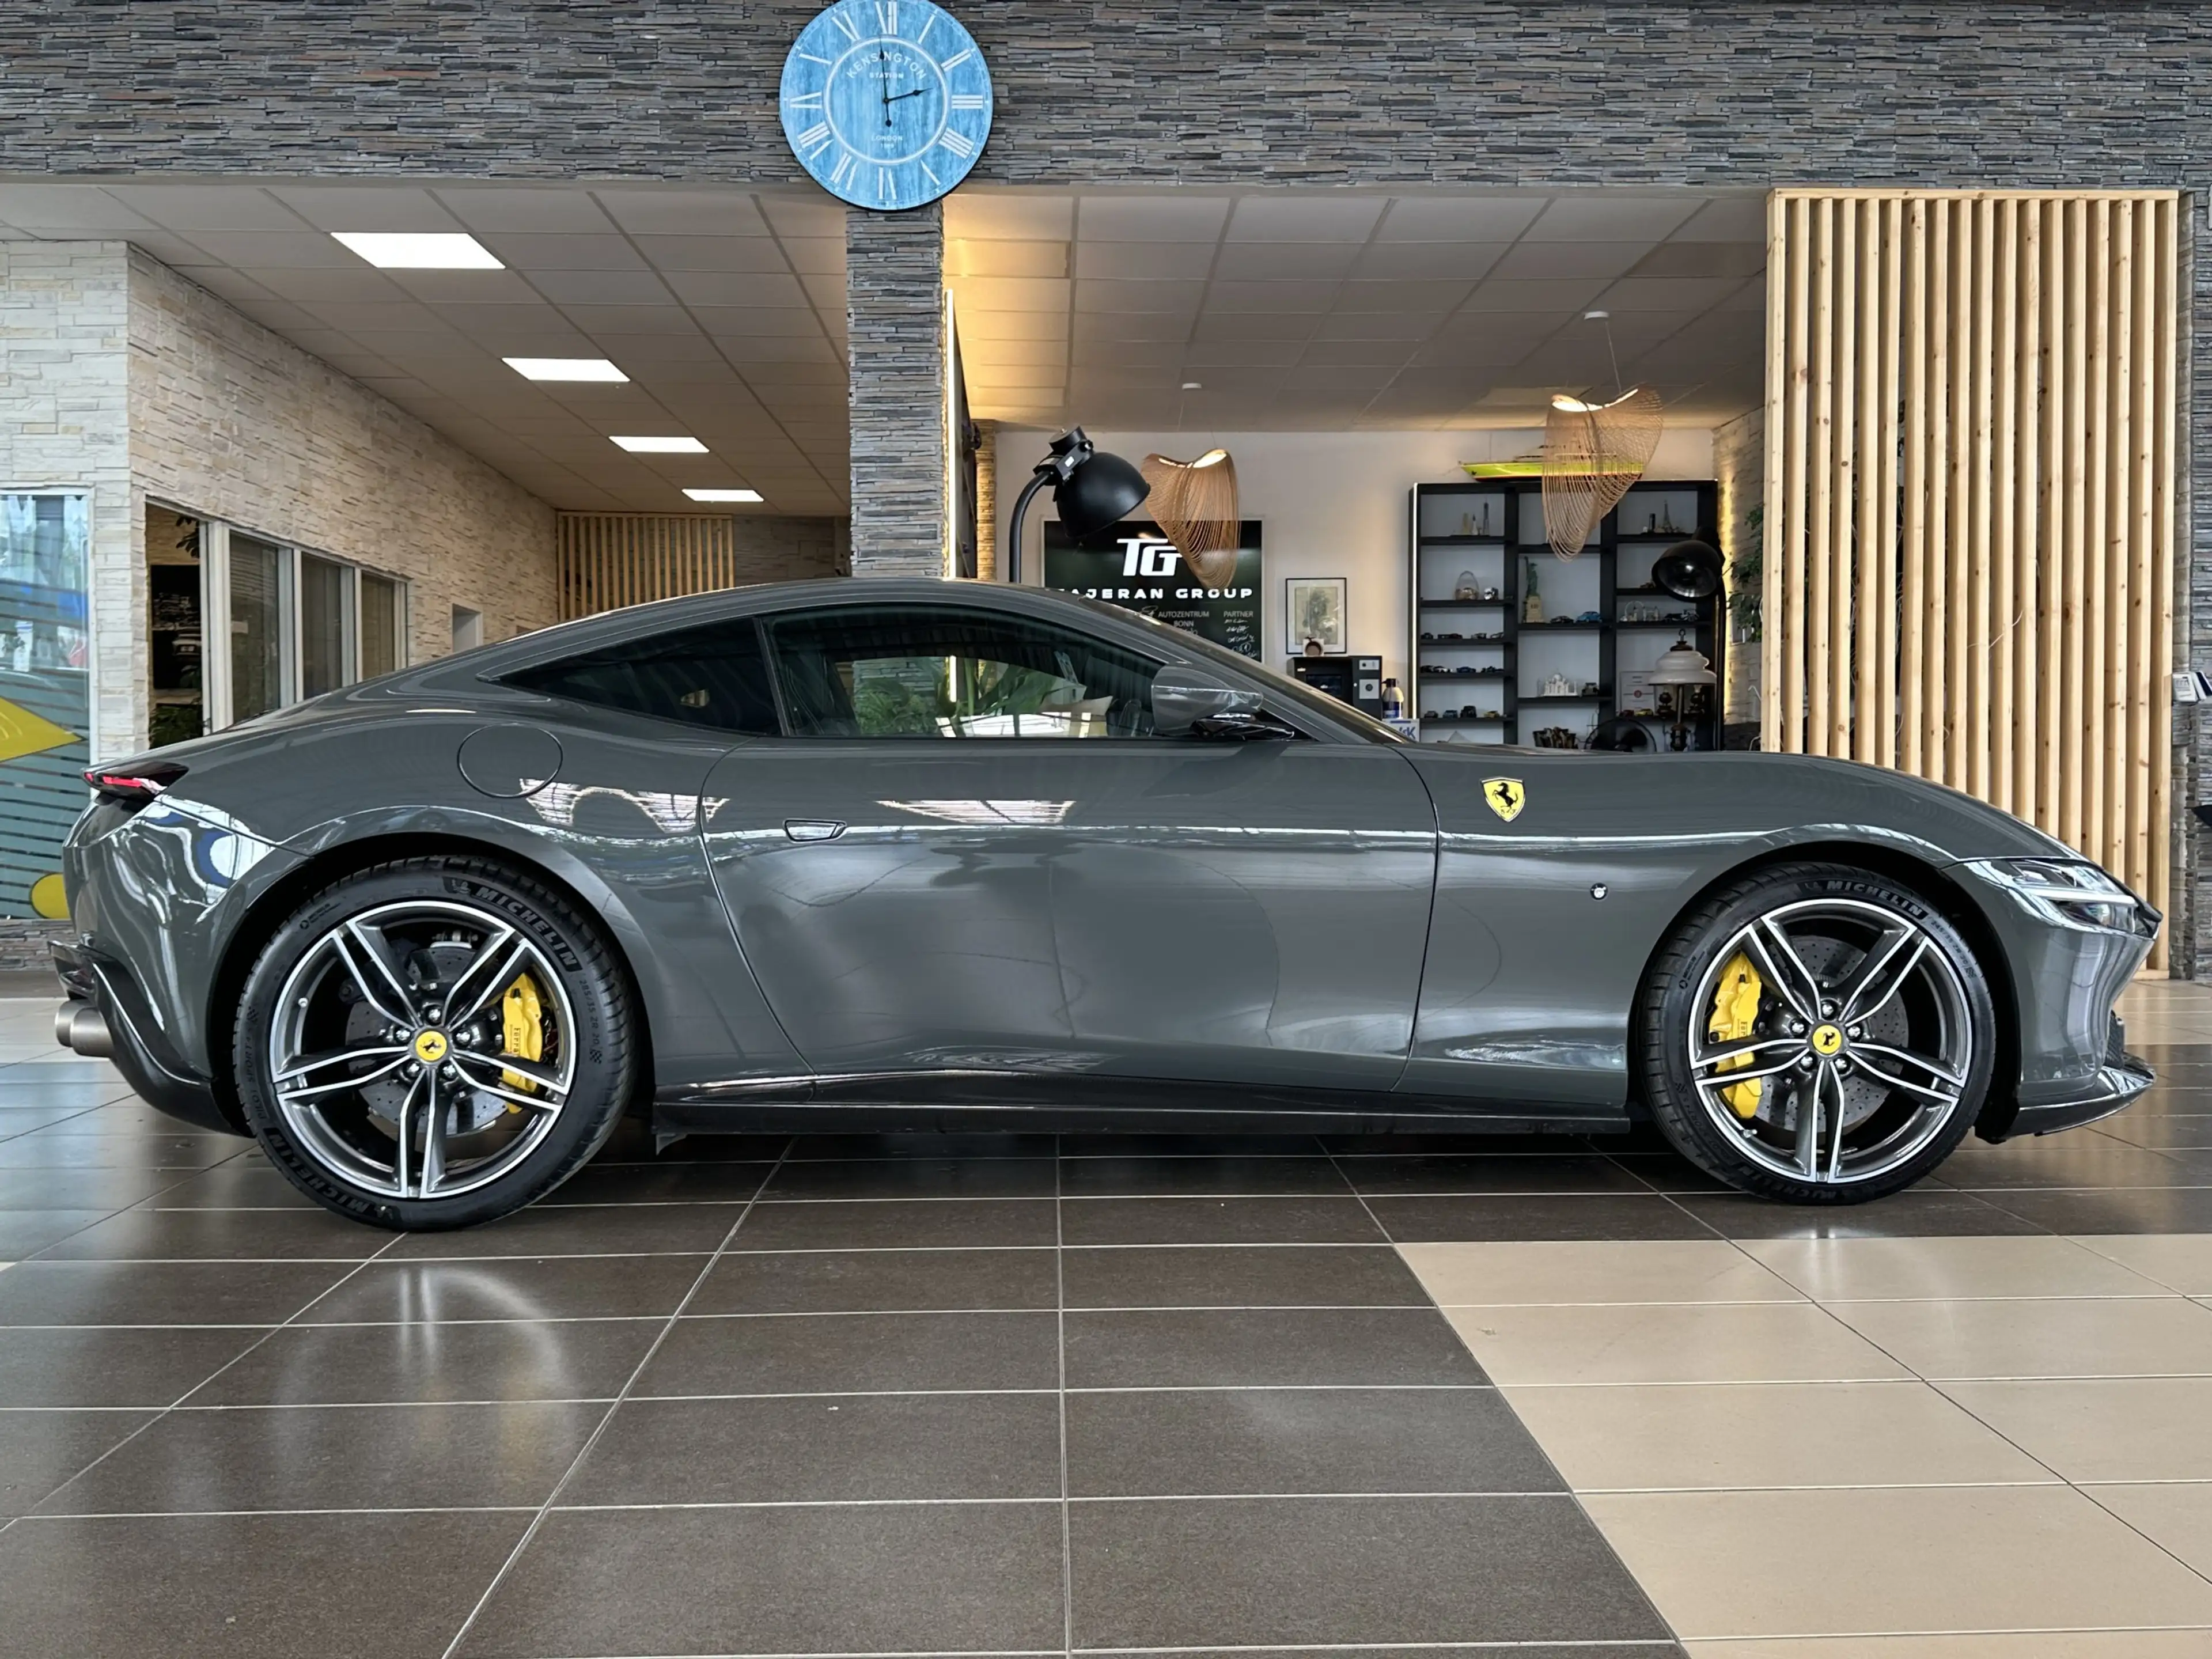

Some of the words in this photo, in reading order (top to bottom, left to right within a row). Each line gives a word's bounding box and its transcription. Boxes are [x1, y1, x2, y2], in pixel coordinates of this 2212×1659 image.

[846, 51, 927, 79] KENSNGTON
[1116, 538, 1183, 577] TG
[1176, 588, 1253, 599] GROUP
[1827, 881, 1923, 916] MICHELIN
[475, 887, 578, 967] MICHELIN
[268, 1135, 370, 1213] MICHELIN
